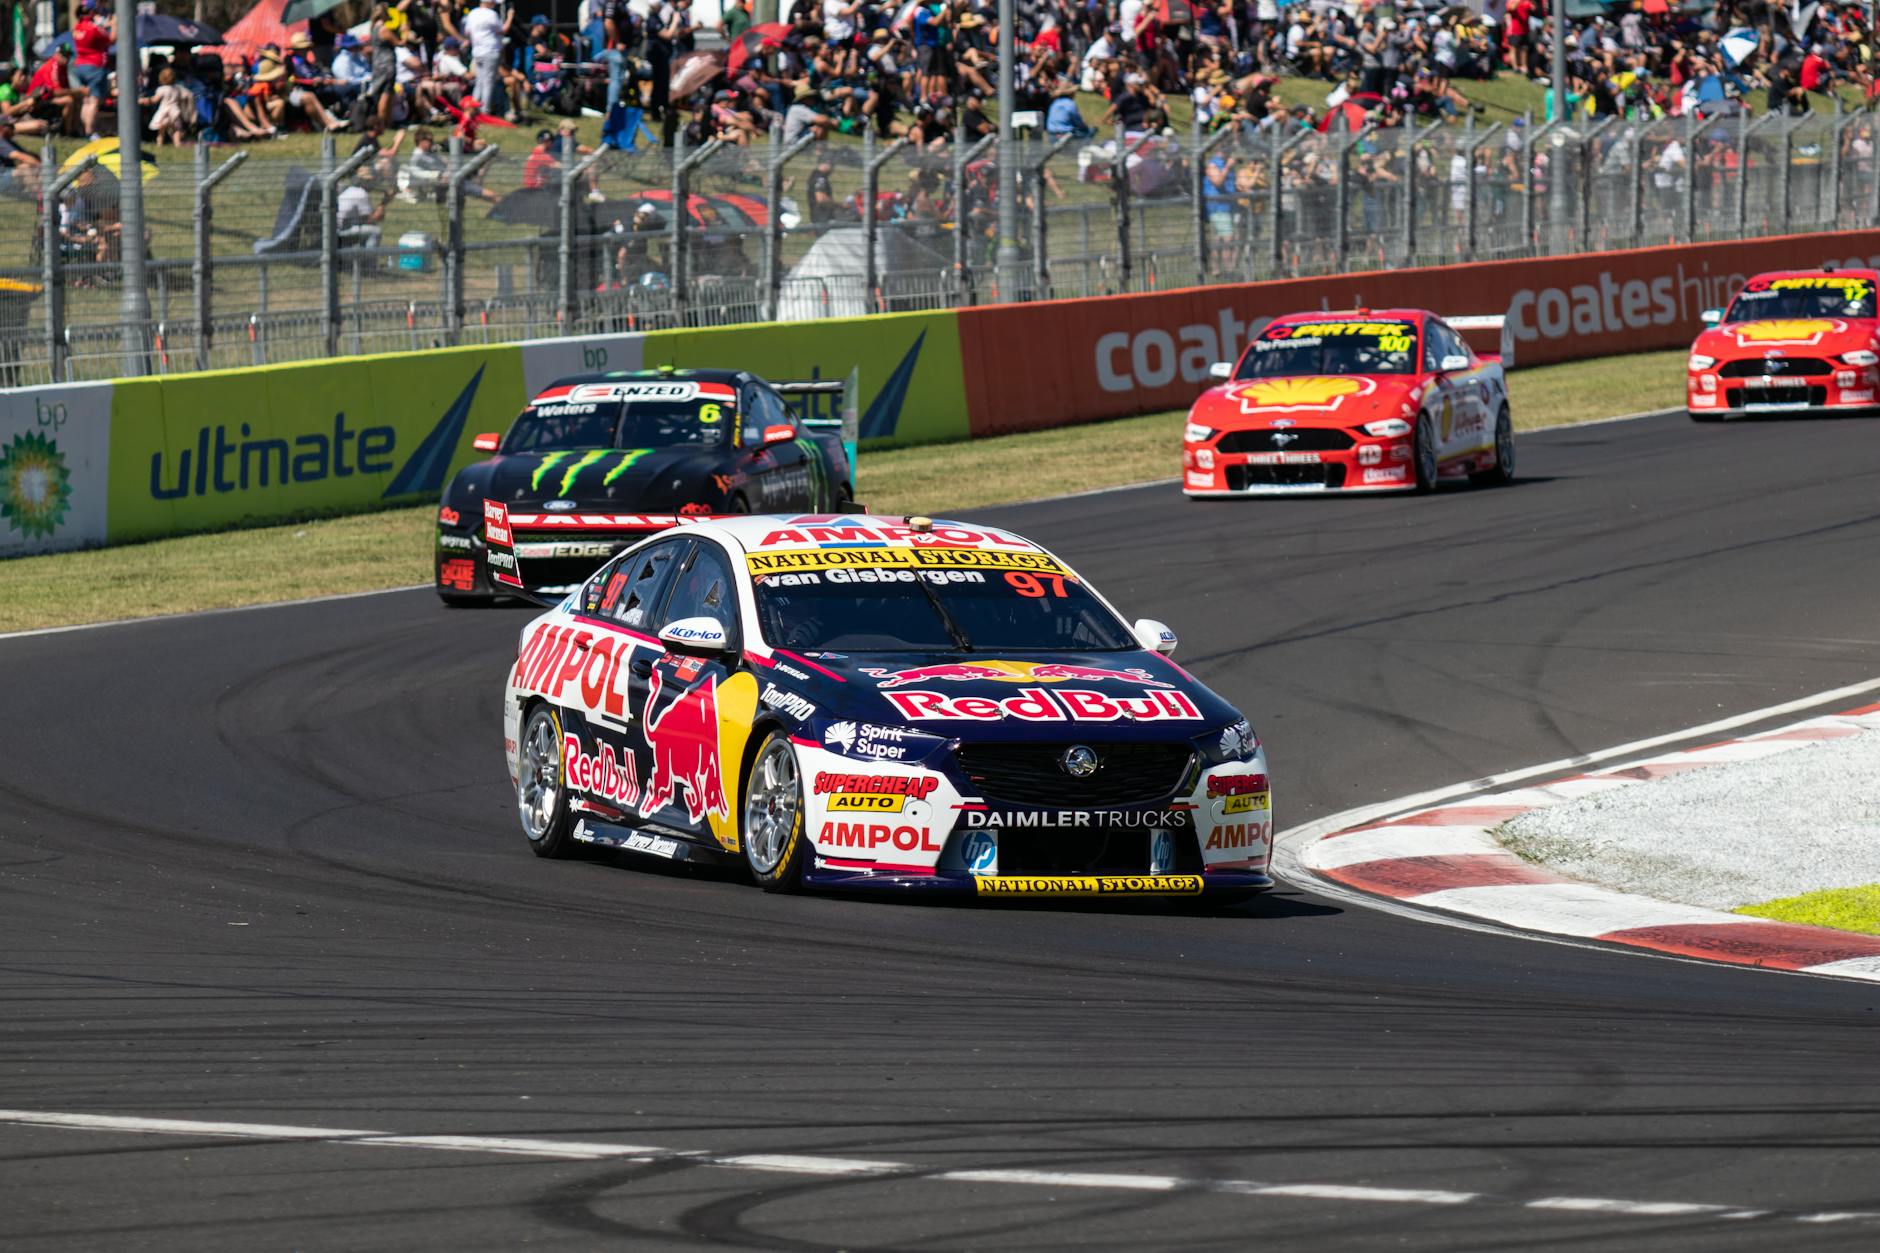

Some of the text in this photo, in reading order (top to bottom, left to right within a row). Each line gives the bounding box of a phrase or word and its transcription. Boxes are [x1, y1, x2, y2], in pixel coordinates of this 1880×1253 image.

[1291, 323, 1410, 338] PIRTEK
[1095, 307, 1273, 392] coat
[1378, 336, 1410, 352] 100
[583, 344, 608, 371] bp
[613, 386, 684, 396] ENZED
[36, 397, 67, 432] bp
[537, 403, 598, 418] Waters
[699, 403, 722, 423] 6
[151, 412, 395, 500] ultimate
[485, 501, 505, 524] Harvey
[486, 522, 509, 543] Norman
[759, 526, 1033, 548] AMPOL
[487, 549, 514, 569] ToolPRO
[556, 543, 615, 557] EDGE
[750, 549, 1052, 570] NATIONAL STORAGE
[764, 567, 986, 588] van Gisbergen
[1003, 571, 1069, 598] 97
[512, 622, 629, 716] AMPOL
[760, 682, 816, 722] ToolPRO
[881, 687, 1205, 722] Red Bull
[859, 723, 903, 742] Spirit
[856, 738, 906, 760] Super
[564, 731, 641, 808] Red Bull
[813, 770, 940, 801] SUPERCHEAP
[836, 796, 894, 808] AUTO
[1231, 794, 1267, 809] AUTO
[967, 810, 1187, 828] DAIMLER TRUCKS
[818, 821, 941, 852] AMPOL
[982, 876, 1196, 893] NATIONAL STORAGE
